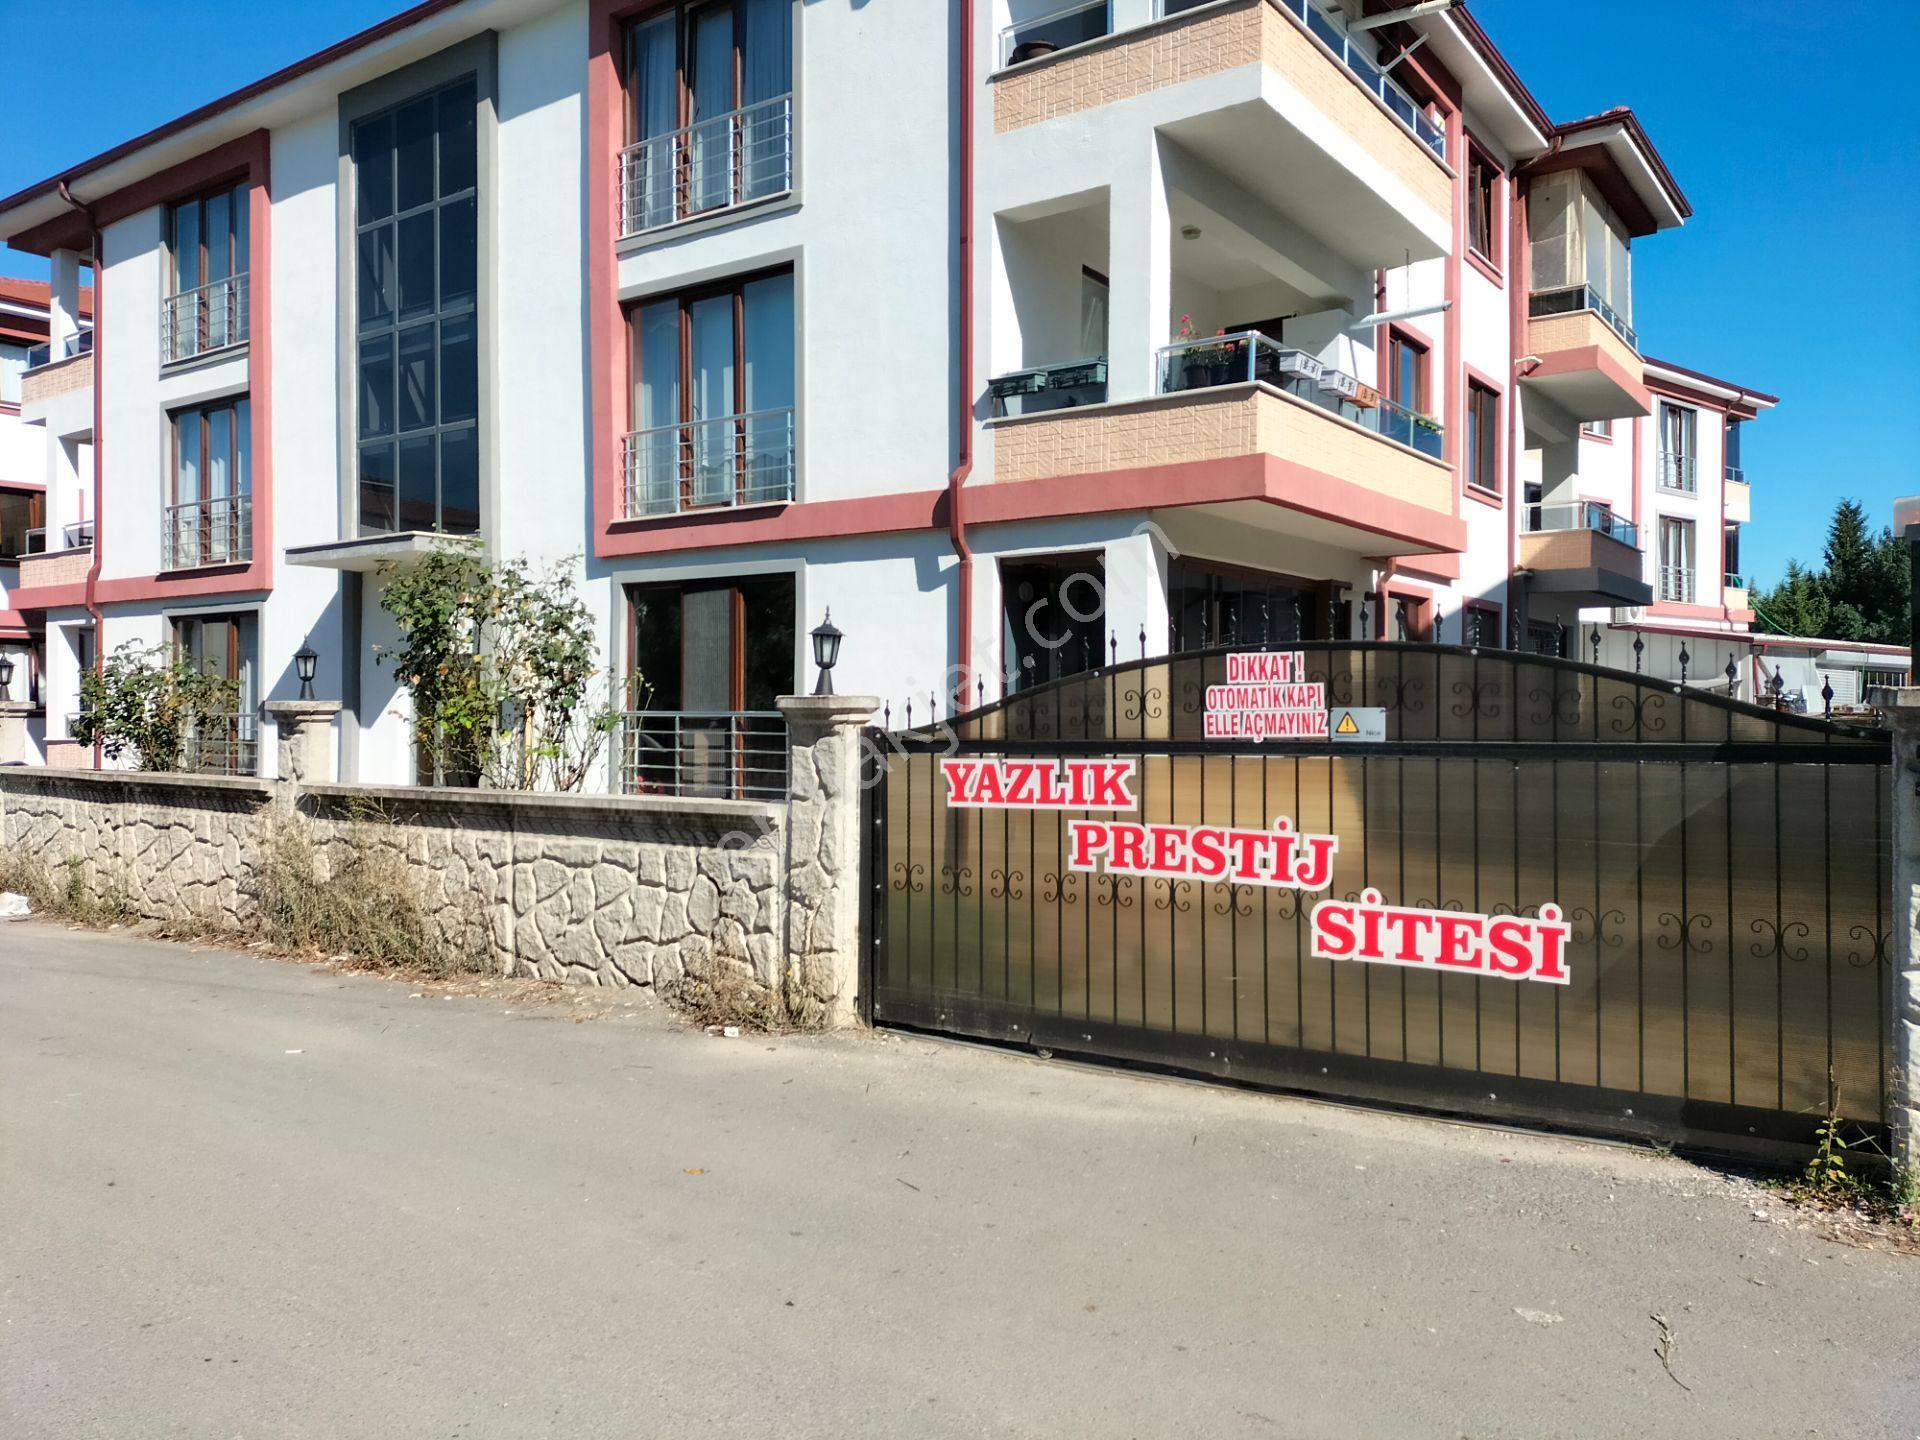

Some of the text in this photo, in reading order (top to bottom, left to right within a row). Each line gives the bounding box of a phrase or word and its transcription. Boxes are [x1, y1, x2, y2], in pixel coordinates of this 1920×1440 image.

[1287, 685, 1322, 708] KAPI
[1207, 712, 1326, 739] ELLE AÇMAYINIZ
[942, 762, 1133, 806] YAZLIK
[1072, 819, 1335, 887] PRESTİJ
[1315, 892, 1566, 980] SİTESİ
